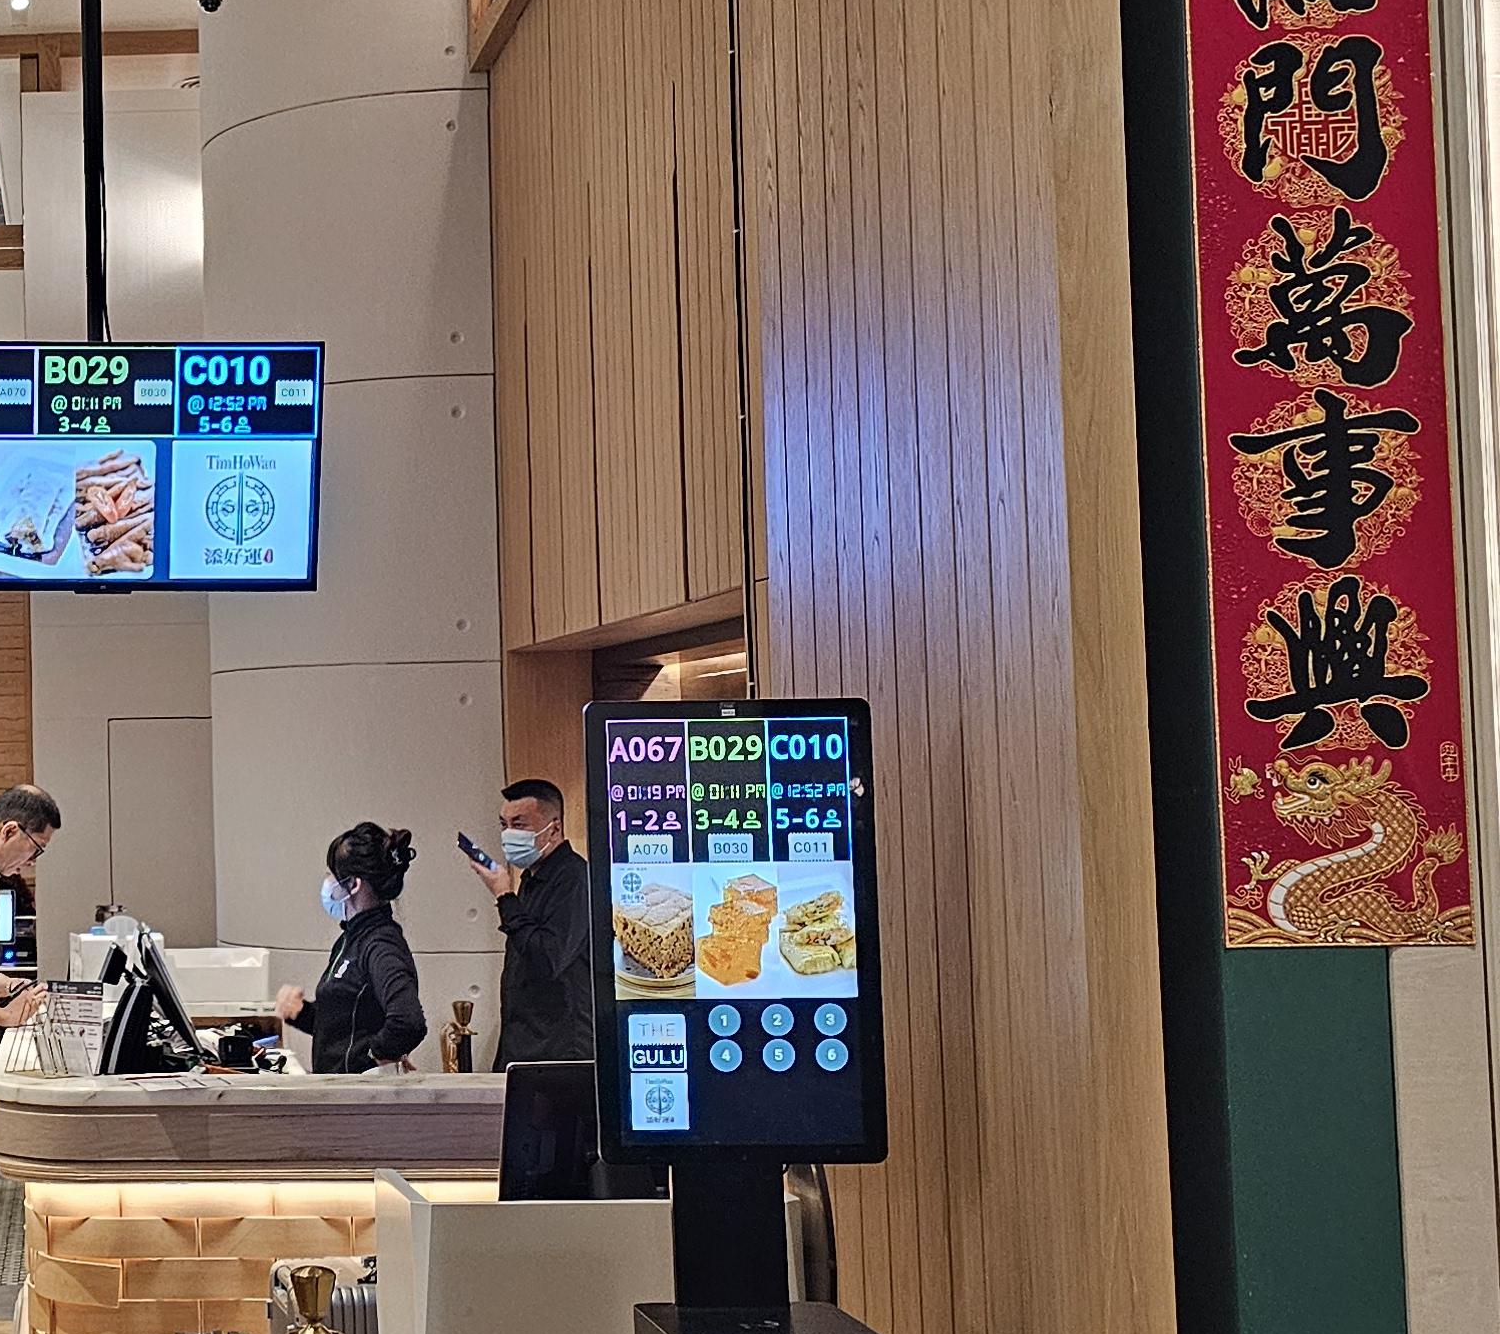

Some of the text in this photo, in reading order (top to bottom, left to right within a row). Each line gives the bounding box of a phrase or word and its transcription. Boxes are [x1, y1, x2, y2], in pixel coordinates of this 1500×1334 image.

[44, 355, 129, 385] B029
[183, 355, 271, 385] C010
[0, 387, 26, 397] A070
[140, 388, 167, 397] B030
[281, 388, 307, 397] C011
[102, 396, 122, 411] PM
[208, 396, 245, 411] 12:52
[248, 396, 267, 411] PM
[58, 416, 92, 432] 3-4
[199, 416, 233, 433] 5-6
[206, 455, 277, 470] TimHoWan
[609, 736, 683, 762] A067
[690, 735, 763, 761] B029
[770, 733, 843, 760] C010
[665, 785, 686, 799] PM
[745, 784, 766, 798] PM
[787, 784, 823, 798] 12:52
[826, 783, 846, 797] PM
[616, 810, 660, 831] 1-2
[695, 809, 740, 830] 3-4
[776, 808, 820, 829] 5-6
[633, 844, 668, 855] A070
[713, 842, 748, 855] B030
[793, 841, 828, 854] C011
[720, 1014, 729, 1027] 1
[772, 1014, 782, 1026] 2
[825, 1013, 835, 1026] 3
[638, 1022, 676, 1037] THE
[632, 1049, 685, 1065] GULU
[721, 1049, 731, 1062] 4
[774, 1049, 784, 1061] 5
[827, 1048, 837, 1061] 6
